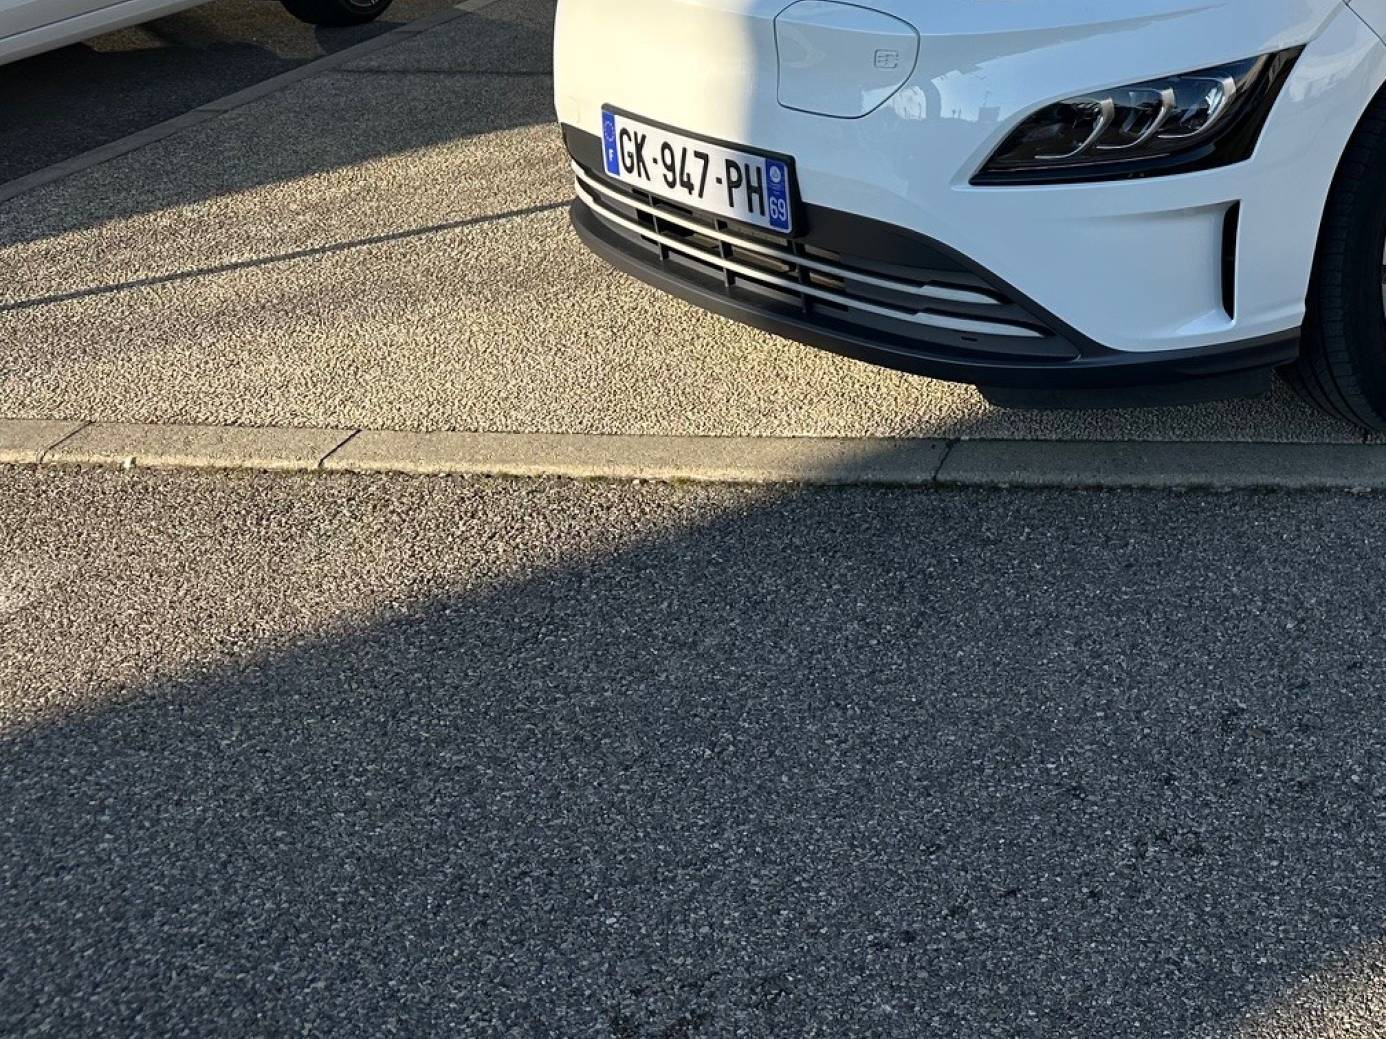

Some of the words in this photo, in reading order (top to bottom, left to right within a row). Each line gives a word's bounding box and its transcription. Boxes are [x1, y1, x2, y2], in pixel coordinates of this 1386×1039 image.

[608, 148, 615, 163] F
[618, 126, 767, 218] GK-947-PH
[769, 195, 787, 222] 69
